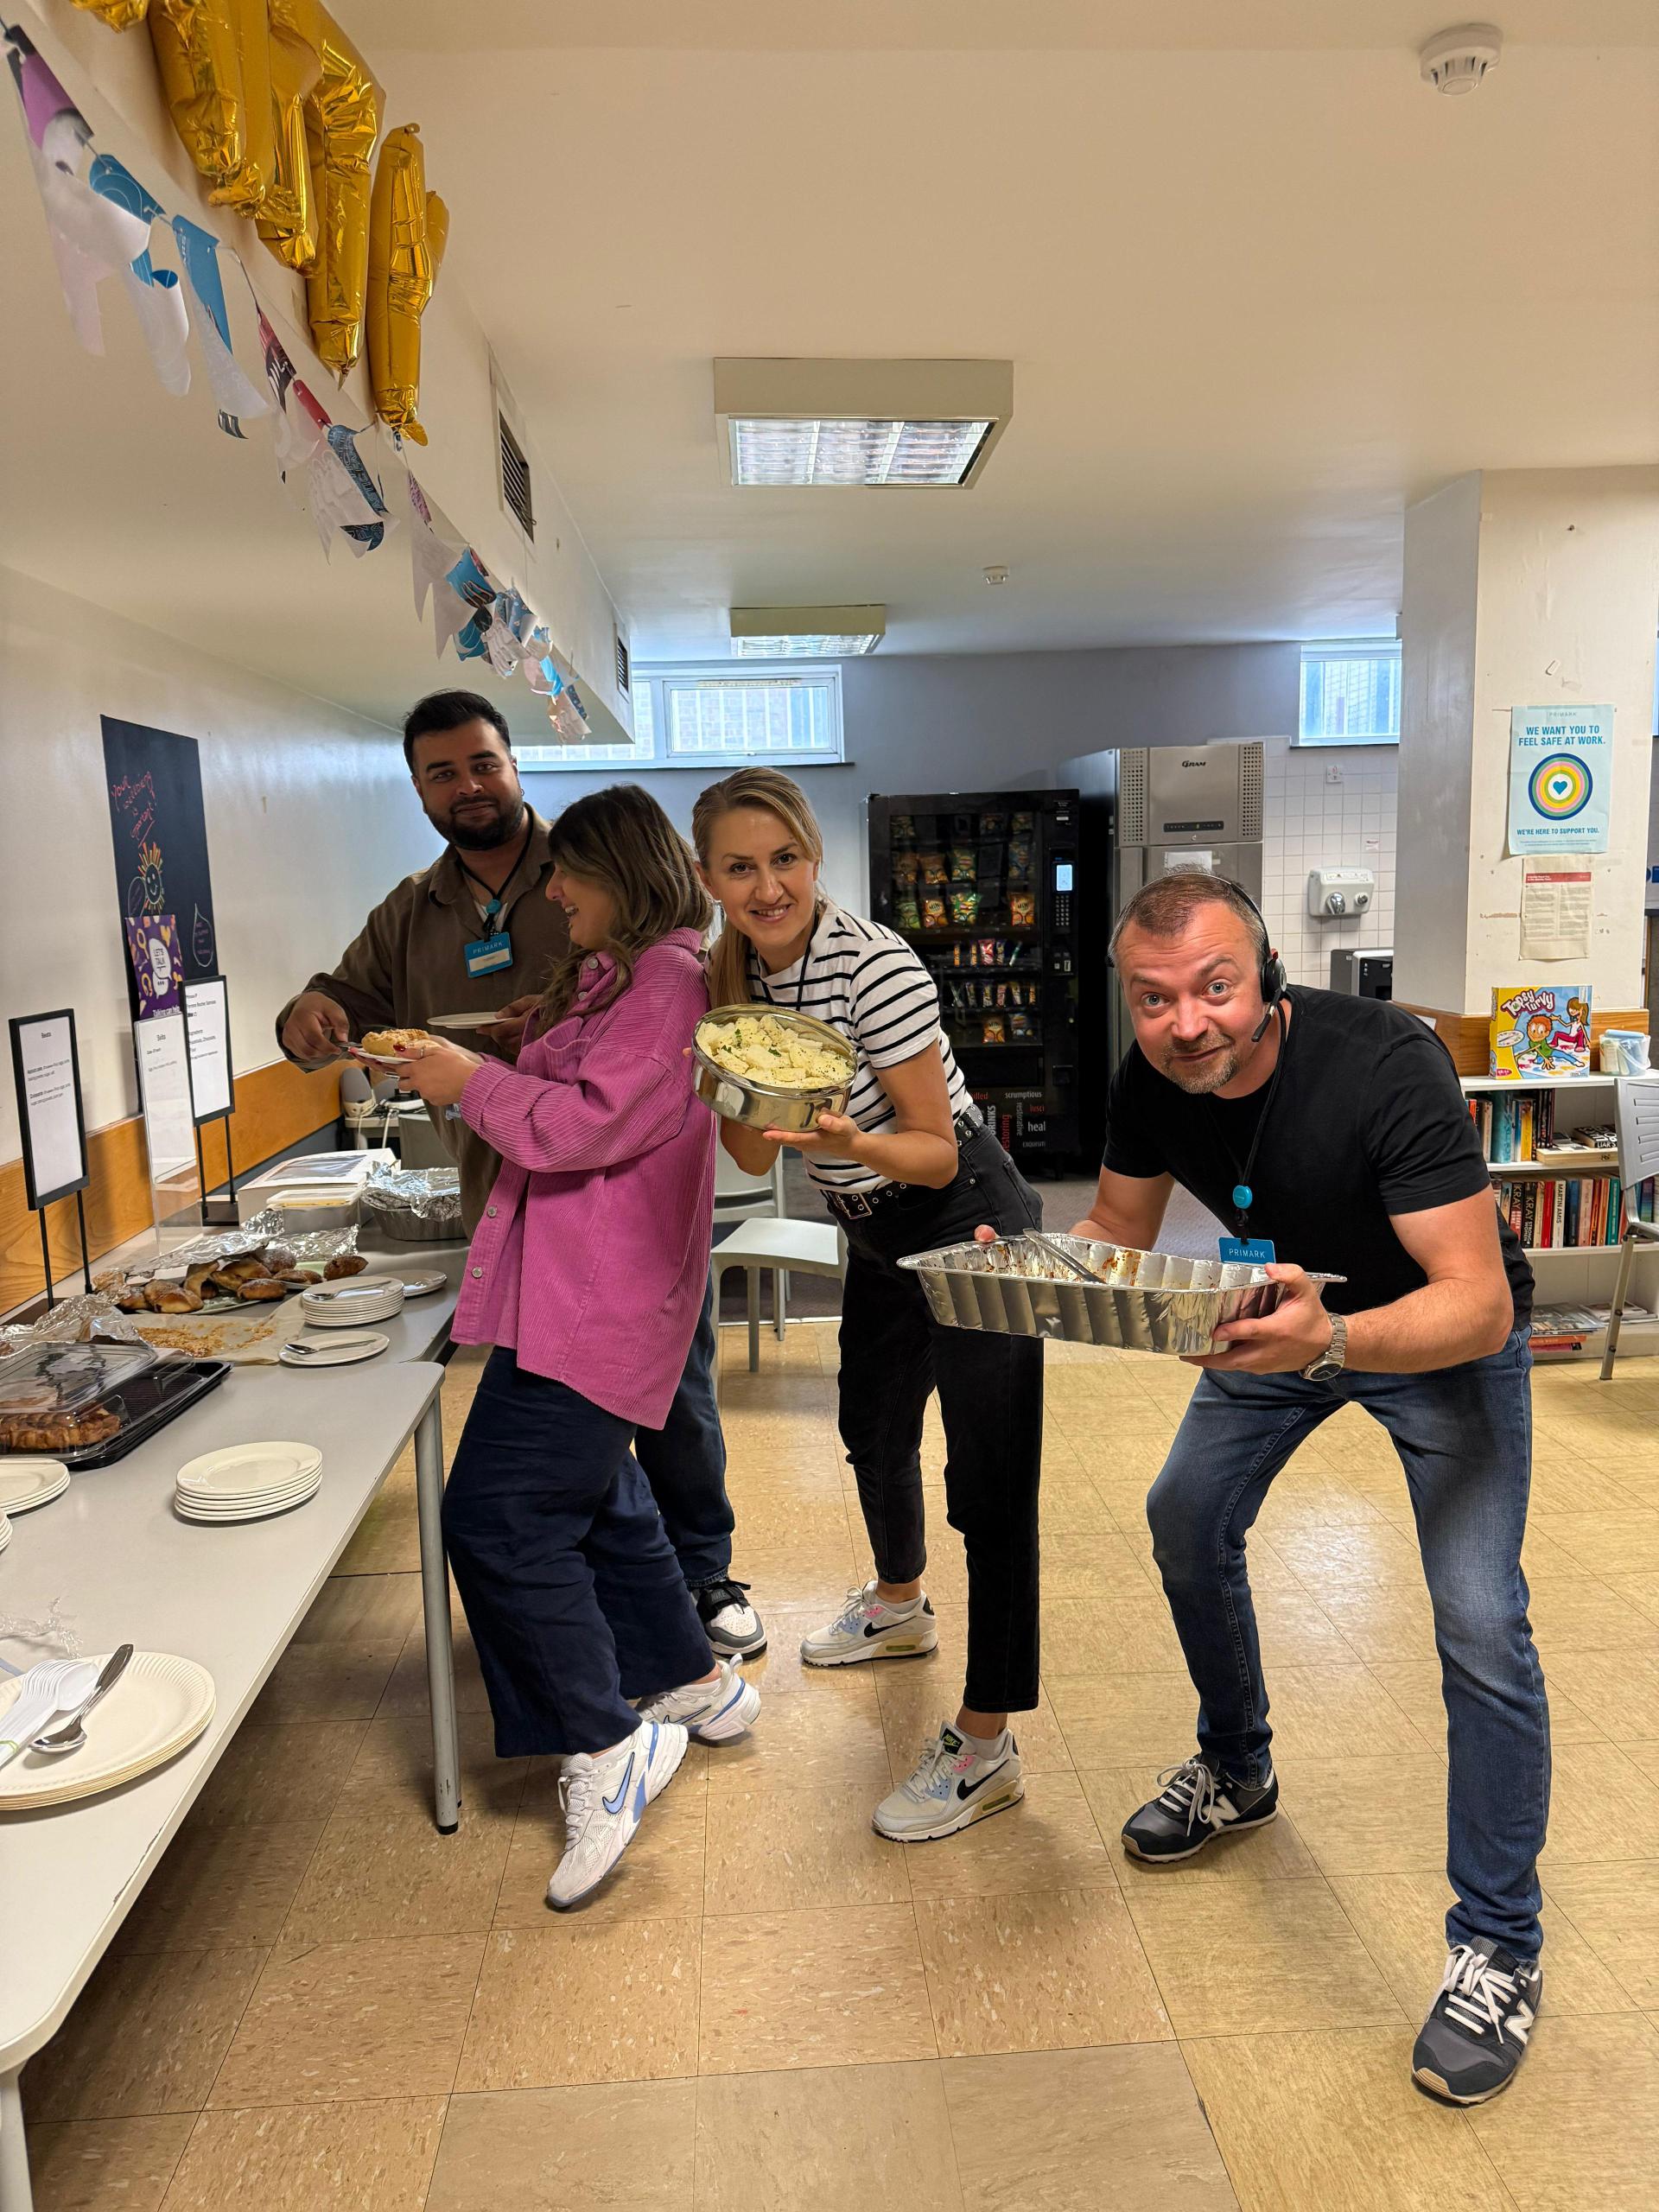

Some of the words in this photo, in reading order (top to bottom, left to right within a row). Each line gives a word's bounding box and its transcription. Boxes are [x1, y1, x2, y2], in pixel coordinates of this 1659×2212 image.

[1526, 727, 1540, 735] WE
[1541, 726, 1567, 734] WANT
[1569, 725, 1586, 734] YOU
[1589, 725, 1599, 734] TO
[1518, 737, 1538, 747] FEEL
[1541, 737, 1562, 746] SAFE
[1565, 736, 1575, 745] AT
[1578, 735, 1605, 745] WORK.
[473, 941, 503, 955] PRIMARK
[1502, 990, 1535, 1017] Topsy
[1525, 992, 1554, 1012] Turvy
[1005, 1090, 1042, 1099] scrumptious
[1027, 1121, 1046, 1132] heal
[1512, 1184, 1522, 1210] KRAY
[1525, 1196, 1535, 1220] KRAY
[1229, 1248, 1266, 1259] PRIMARK
